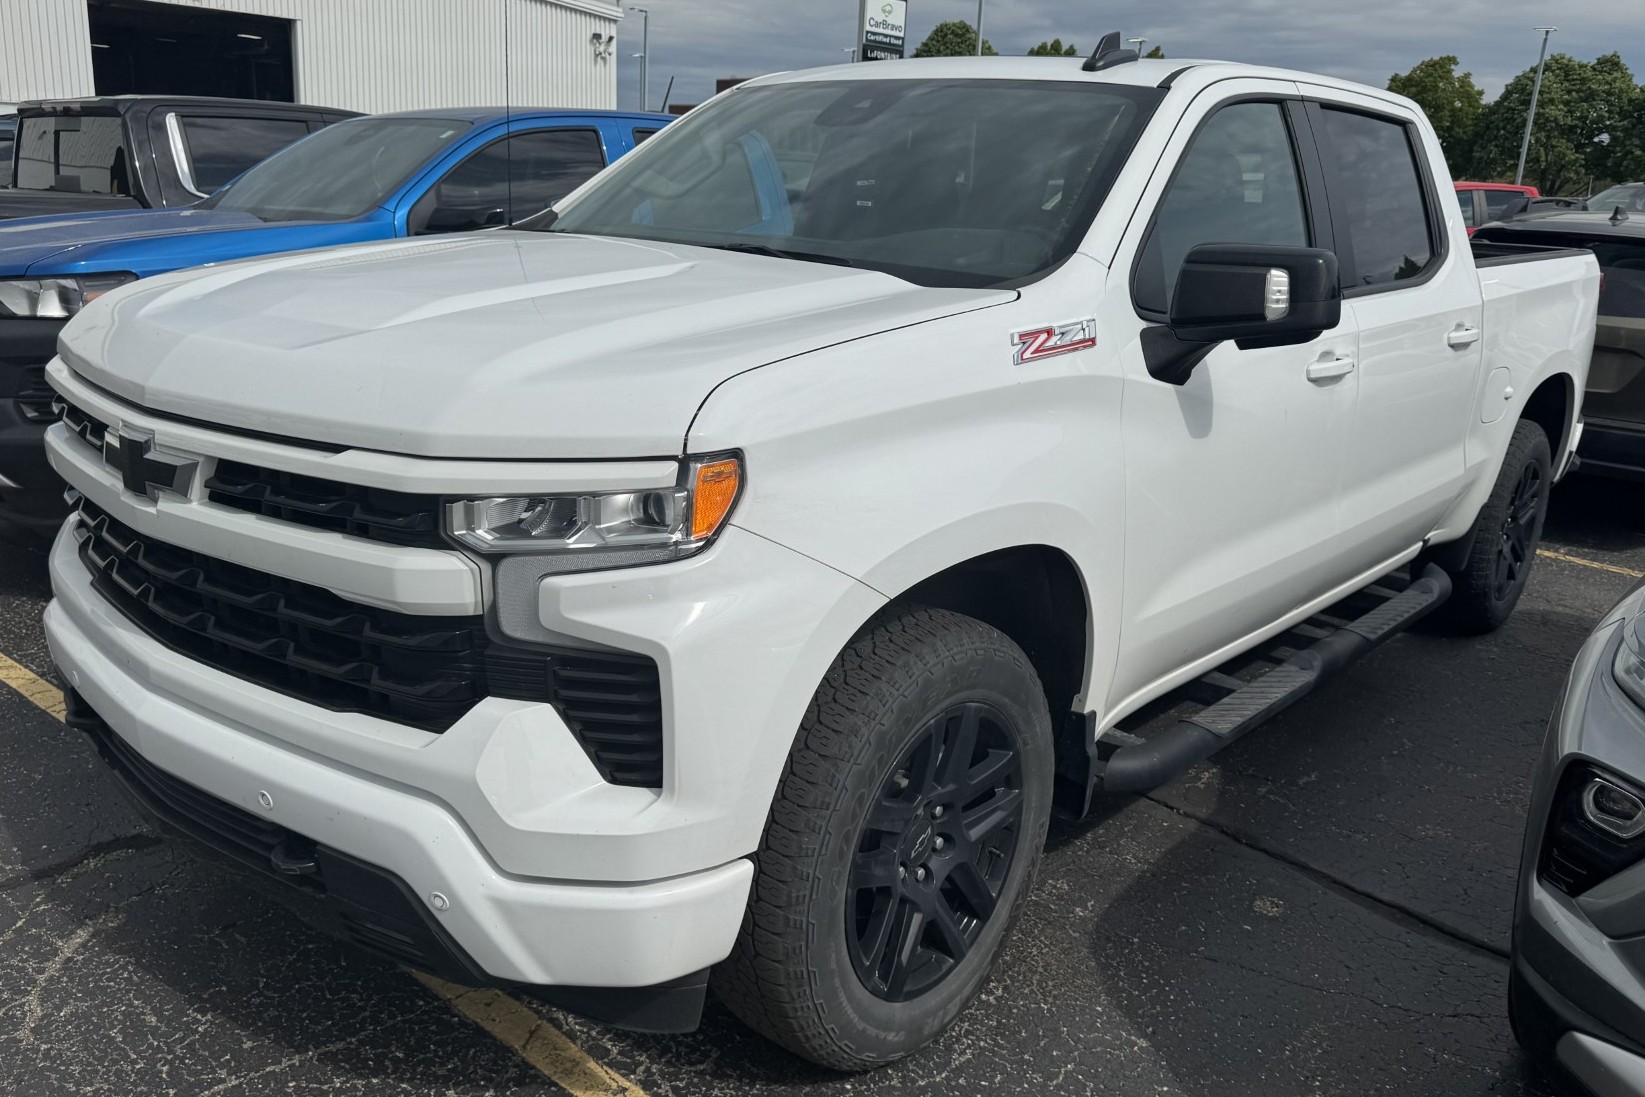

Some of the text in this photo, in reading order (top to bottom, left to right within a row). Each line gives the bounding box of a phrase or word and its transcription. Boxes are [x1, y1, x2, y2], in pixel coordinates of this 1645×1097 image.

[868, 17, 903, 33] CarBravo
[867, 33, 890, 43] Certified
[1011, 318, 1096, 366] Z71
